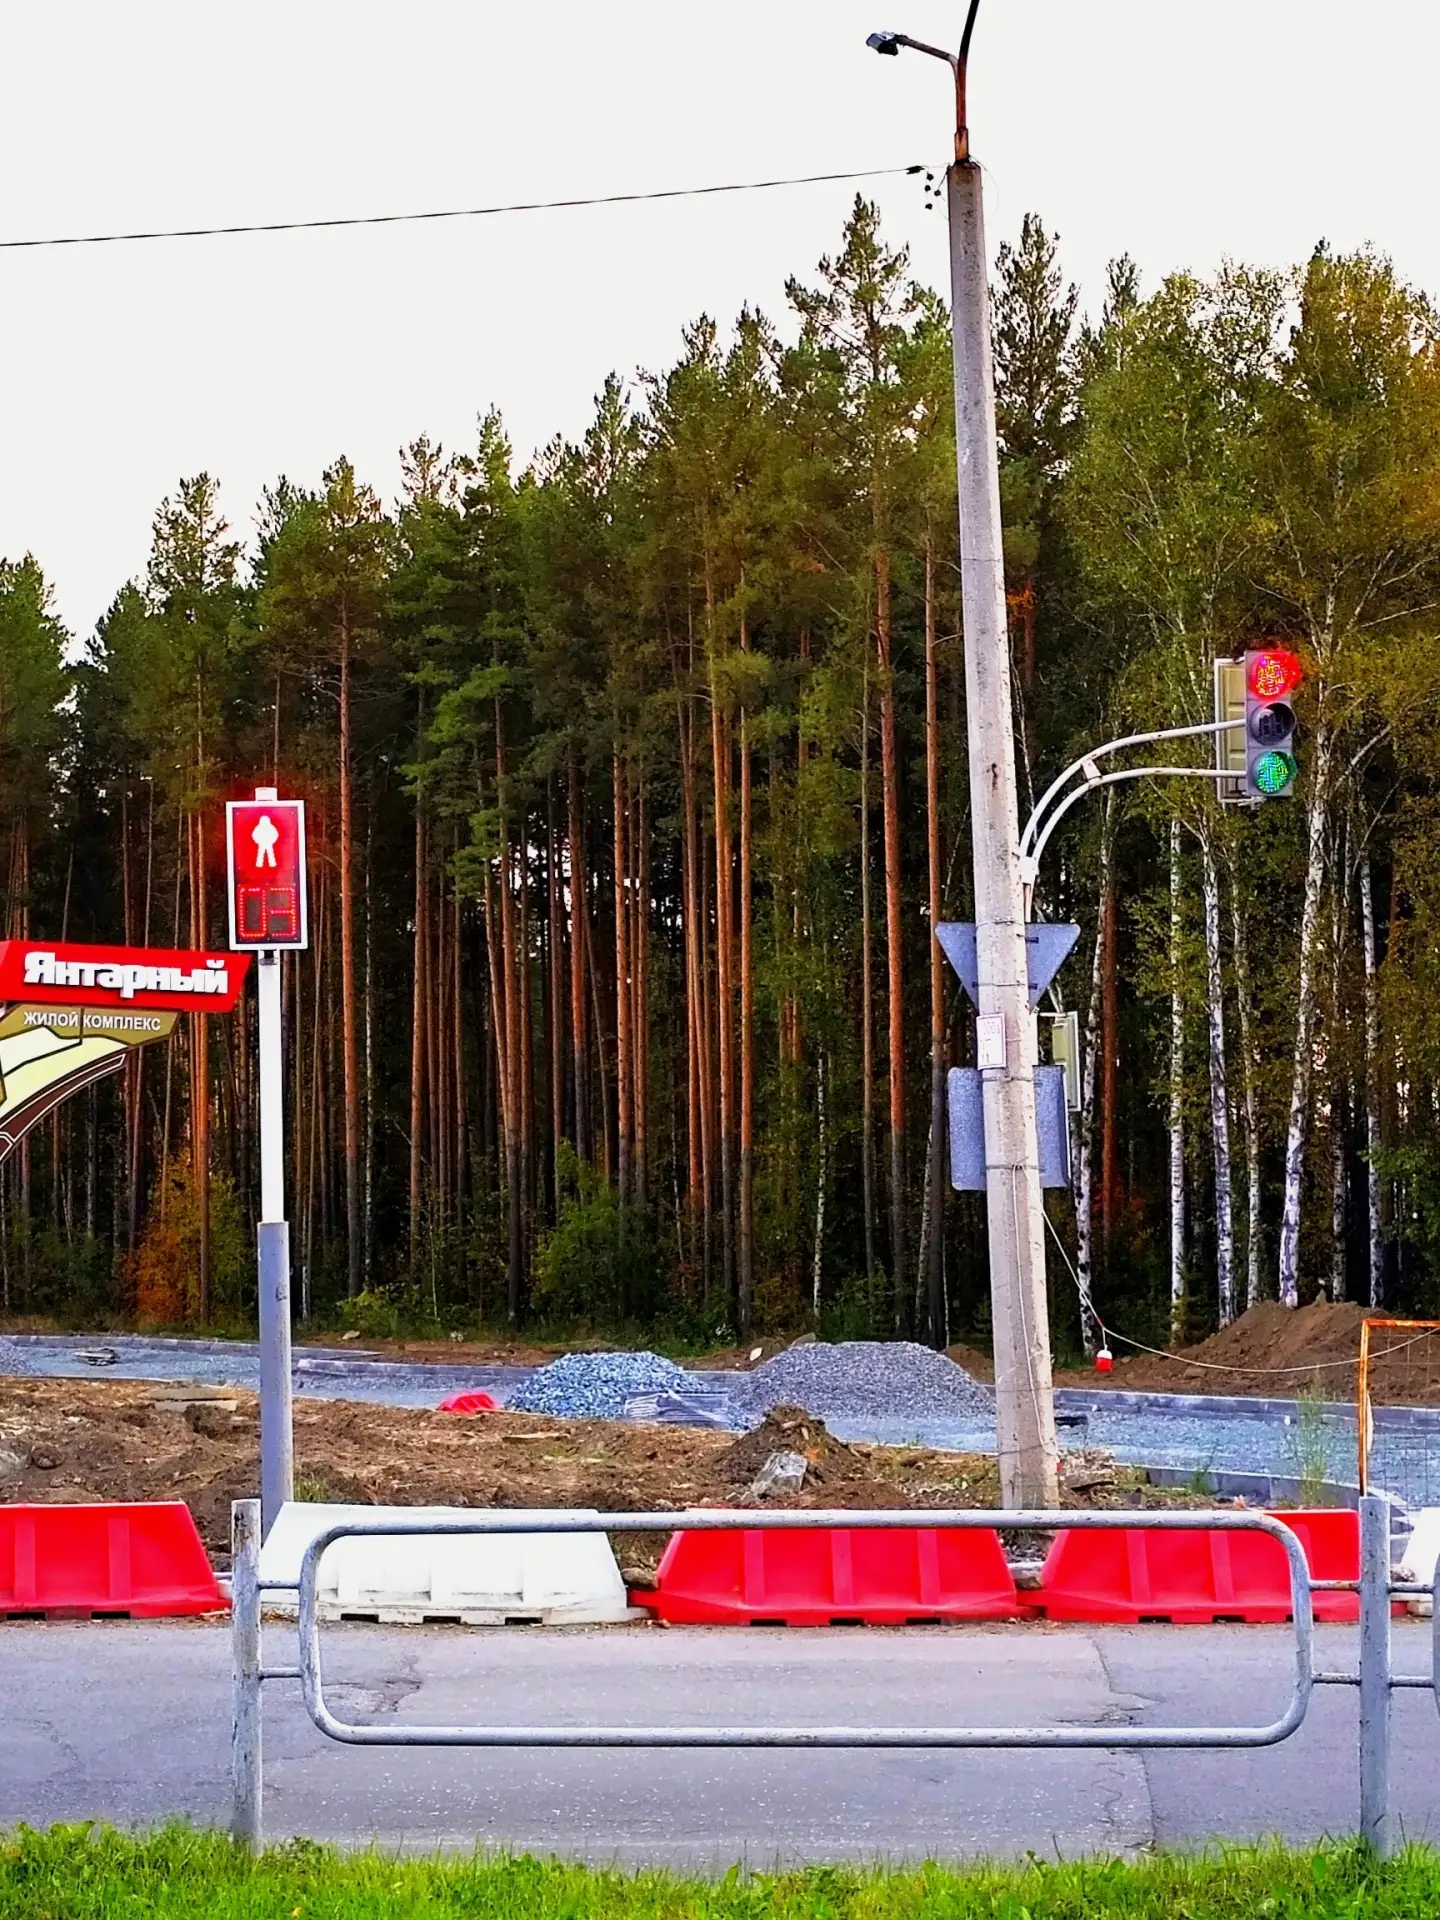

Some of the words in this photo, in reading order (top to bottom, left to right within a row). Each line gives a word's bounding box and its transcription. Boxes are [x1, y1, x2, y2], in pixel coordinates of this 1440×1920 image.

[24, 951, 229, 999] Янтарный
[23, 1010, 79, 1027] ЖИЛОЙ
[83, 1013, 161, 1031] КОМПЛЕКС
